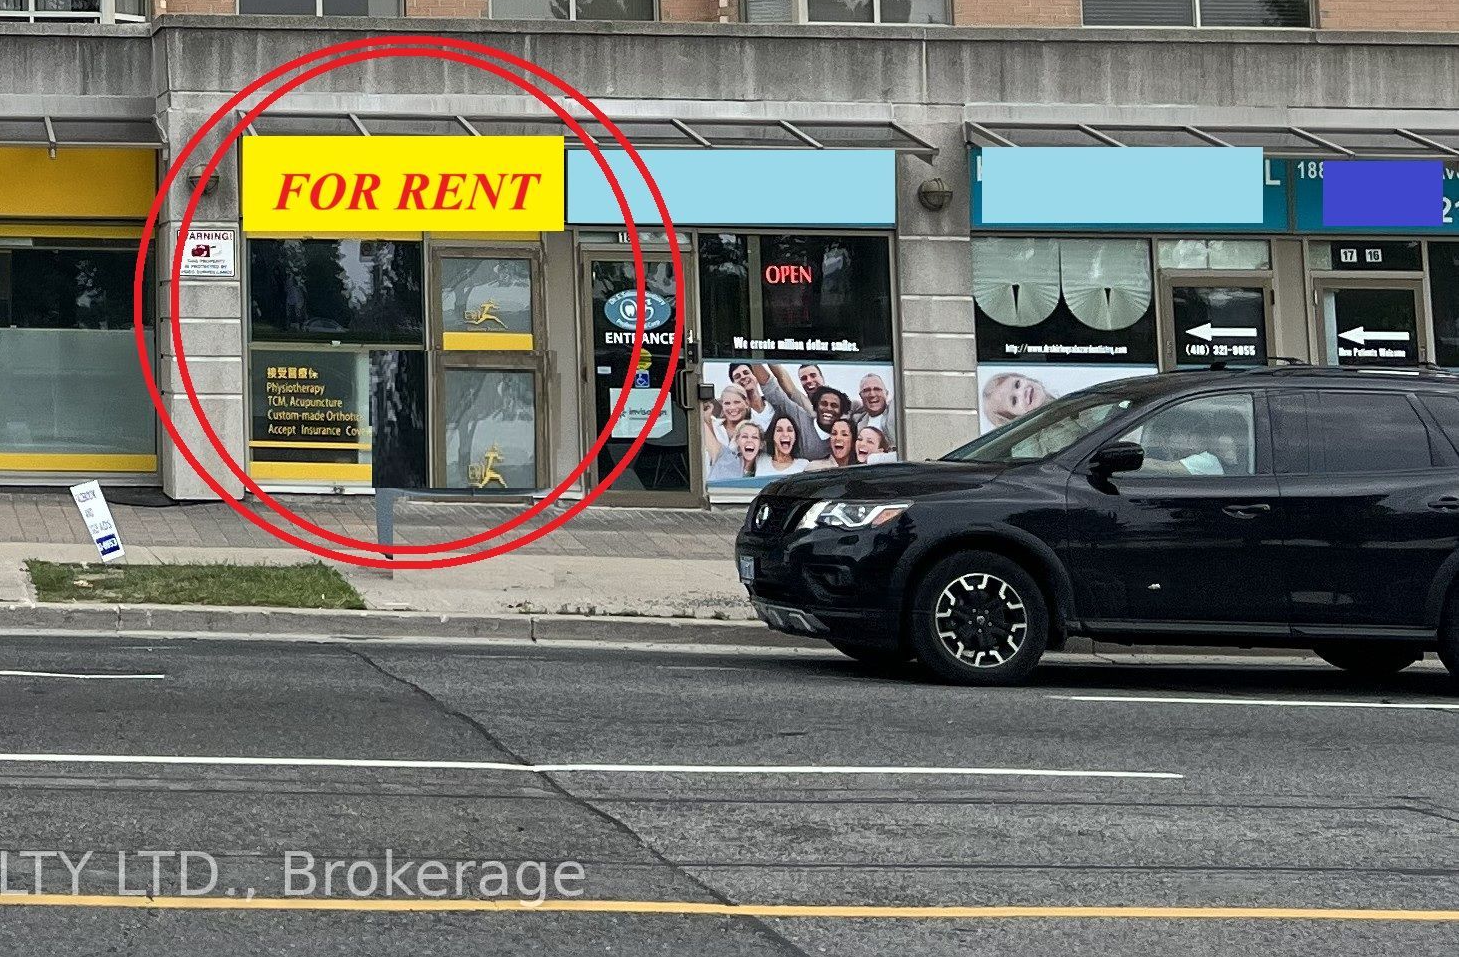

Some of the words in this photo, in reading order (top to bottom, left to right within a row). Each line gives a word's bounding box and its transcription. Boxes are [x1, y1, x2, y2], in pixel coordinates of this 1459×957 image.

[189, 231, 233, 241] ARNING!
[1343, 250, 1355, 261] 17
[1367, 250, 1380, 261] 16
[765, 264, 813, 284] OPEN
[605, 331, 676, 345] ENTANCE
[733, 336, 748, 350] We
[750, 338, 775, 350] create
[806, 338, 828, 351] dollar
[1185, 343, 1210, 356] (416)
[266, 382, 325, 395] Physiotherapy
[267, 395, 288, 407] TCM,
[290, 396, 343, 408] Acupuncture
[267, 409, 325, 421] Custom-made
[268, 424, 297, 436] Accept
[301, 424, 341, 436] Insurance
